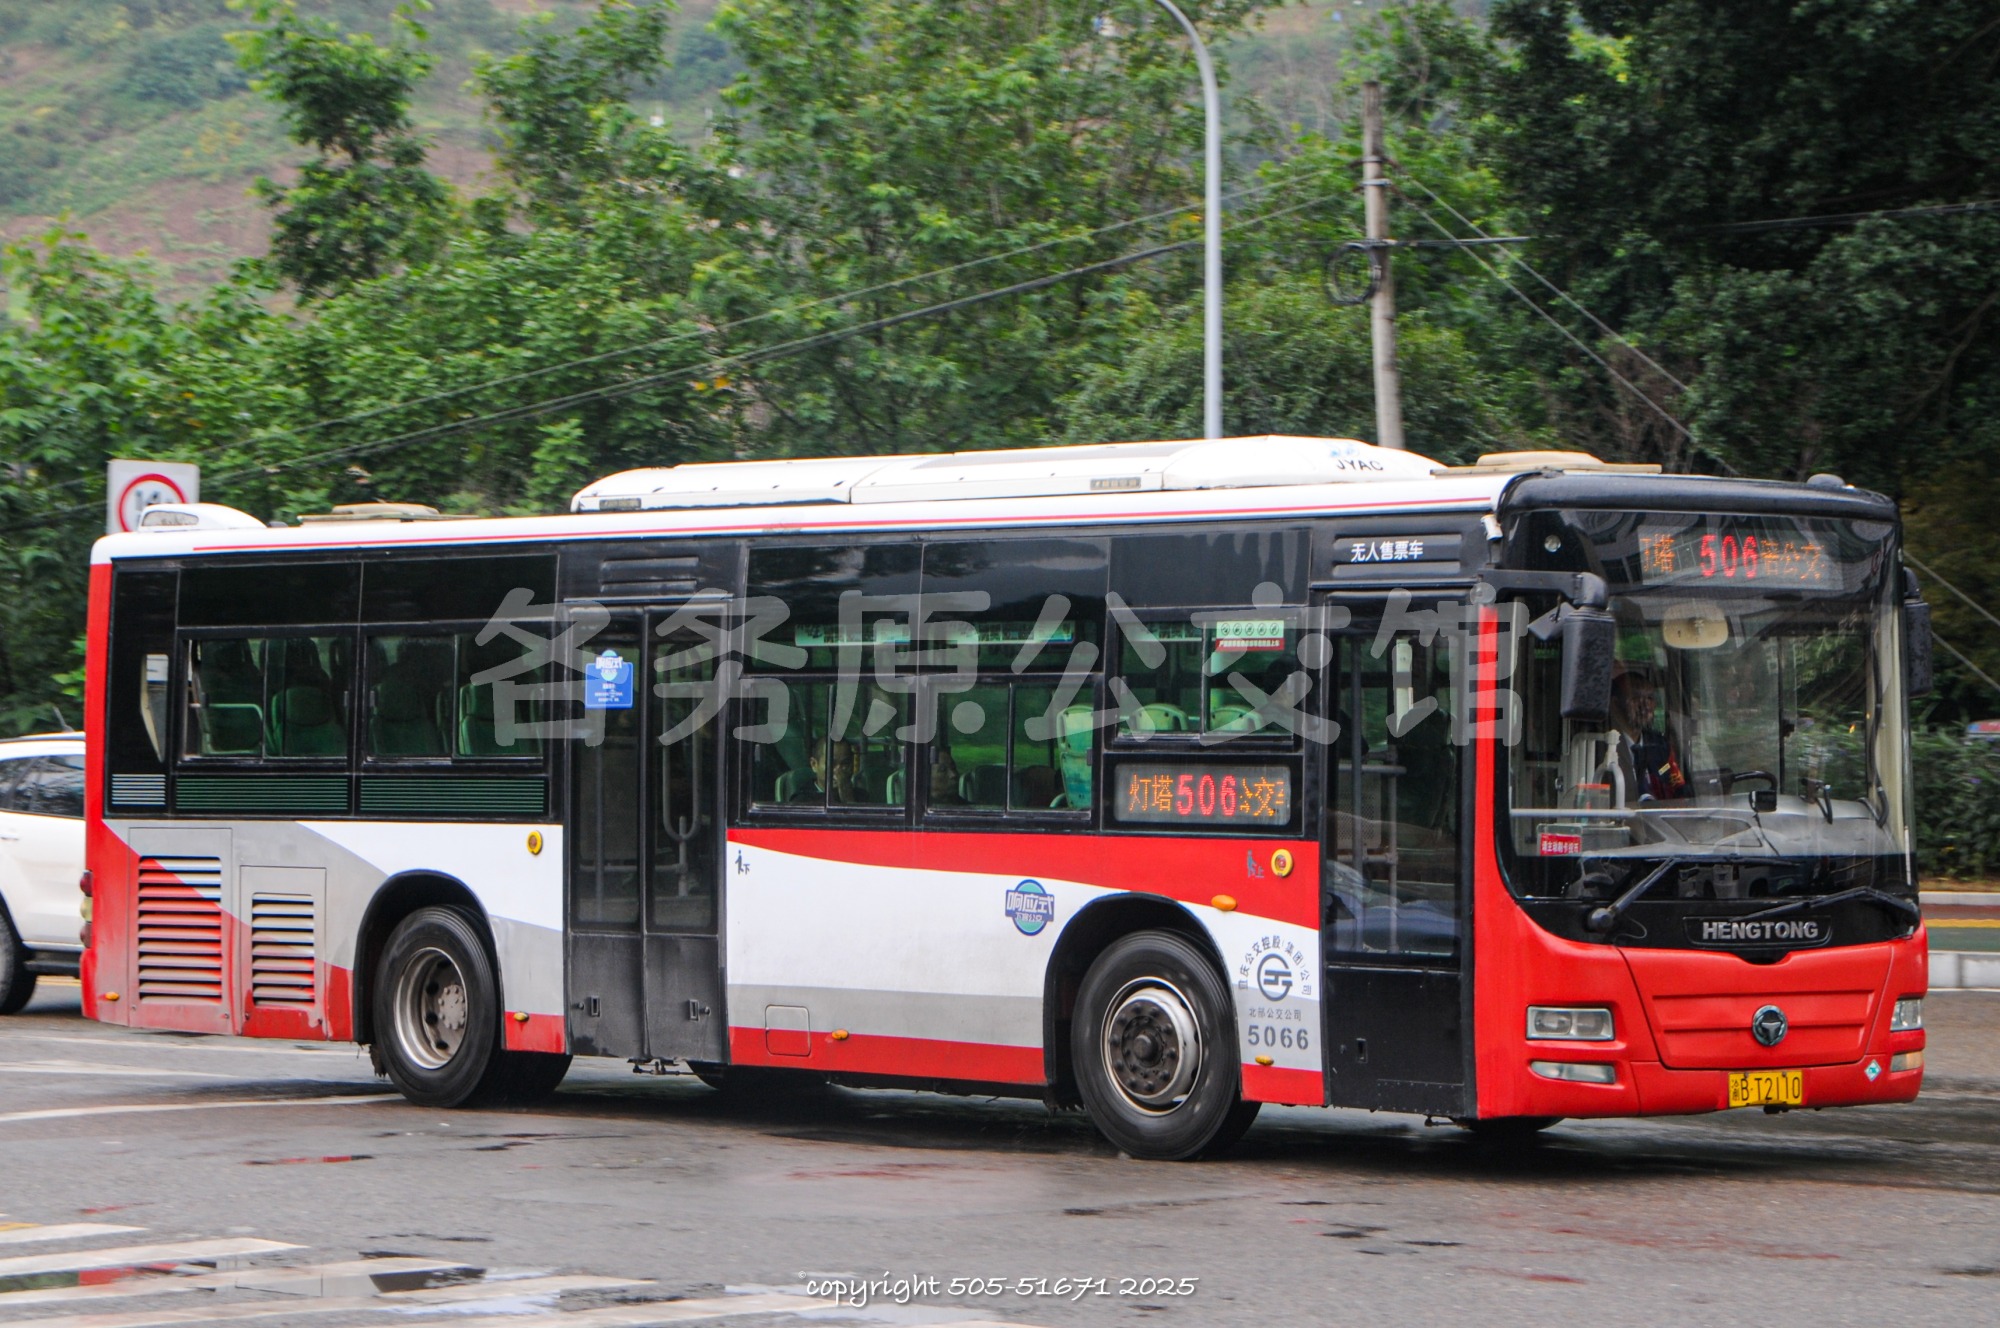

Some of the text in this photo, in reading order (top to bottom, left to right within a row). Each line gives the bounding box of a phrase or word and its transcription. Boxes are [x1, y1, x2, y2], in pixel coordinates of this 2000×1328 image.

[1336, 459, 1384, 471] JYAC
[1350, 539, 1424, 562] 无人售票车
[1701, 534, 1758, 578] 506
[1129, 774, 1173, 811] 灯塔
[1177, 774, 1237, 816] 506
[1007, 891, 1054, 915] 响应式
[1702, 921, 1819, 940] HENGTONG
[1248, 1007, 1302, 1021] 北部公交公司
[1247, 1024, 1309, 1050] 5066
